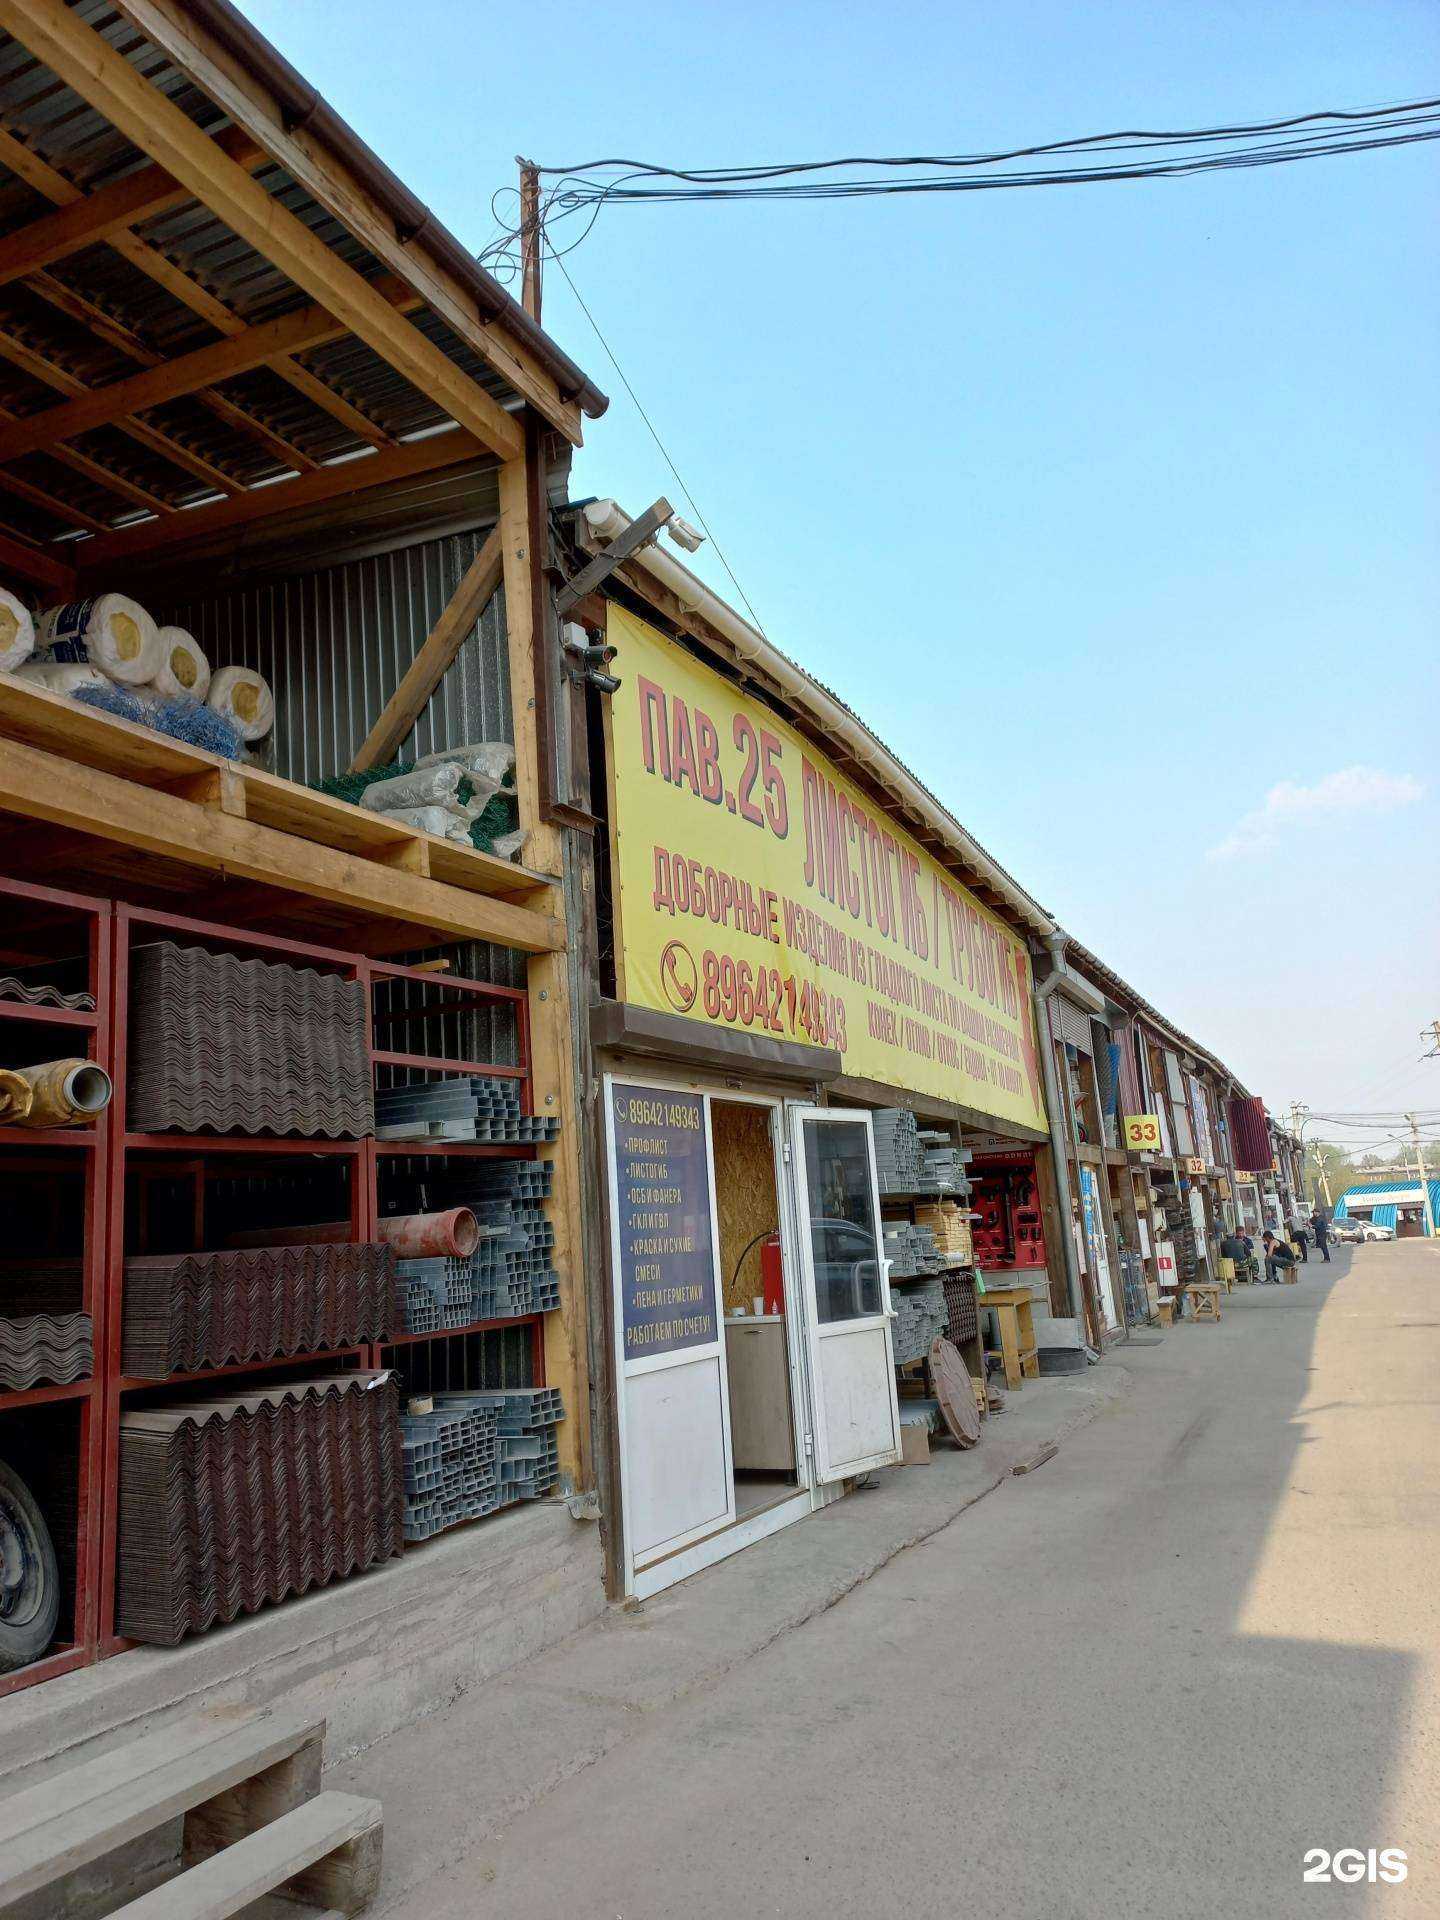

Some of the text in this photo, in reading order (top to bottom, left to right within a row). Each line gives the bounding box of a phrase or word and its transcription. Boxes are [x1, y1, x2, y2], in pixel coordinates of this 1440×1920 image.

[638, 673, 788, 840] ПАВ.25
[802, 754, 928, 961] ЛИСТОГИБ
[940, 879, 1018, 1021] ТРУБОГИБ
[653, 845, 780, 945] ДОБОРНЫЕ
[782, 896, 849, 978] ИЗДЕЛИЯ
[849, 936, 867, 986] ИЗ
[867, 945, 921, 1013] ГЛАДКОГО
[920, 976, 950, 1027] ЛИСТА
[867, 999, 899, 1048] КОНЕК
[905, 1017, 931, 1060] ОТЛИВ
[629, 1099, 700, 1130] 89642149343
[1130, 1123, 1157, 1142] 33
[628, 1137, 668, 1155] ПРОФЛИСТ
[630, 1162, 668, 1179] ЛИСТОГИБ
[1191, 1159, 1203, 1172] 32
[631, 1187, 646, 1204] ОСБ
[652, 1187, 682, 1204] ФАНЕРА
[632, 1213, 648, 1230] ГКЛ
[633, 1238, 663, 1256] КРАСКА
[669, 1236, 691, 1253] СУХИЕ
[635, 1263, 661, 1281] СМЕСИ
[636, 1290, 657, 1308] ПЕНА
[663, 1283, 704, 1304] ГЕРМЕТИКИ
[627, 1314, 711, 1347] РАБОТАЕМ ПО СЧЕТУ!
